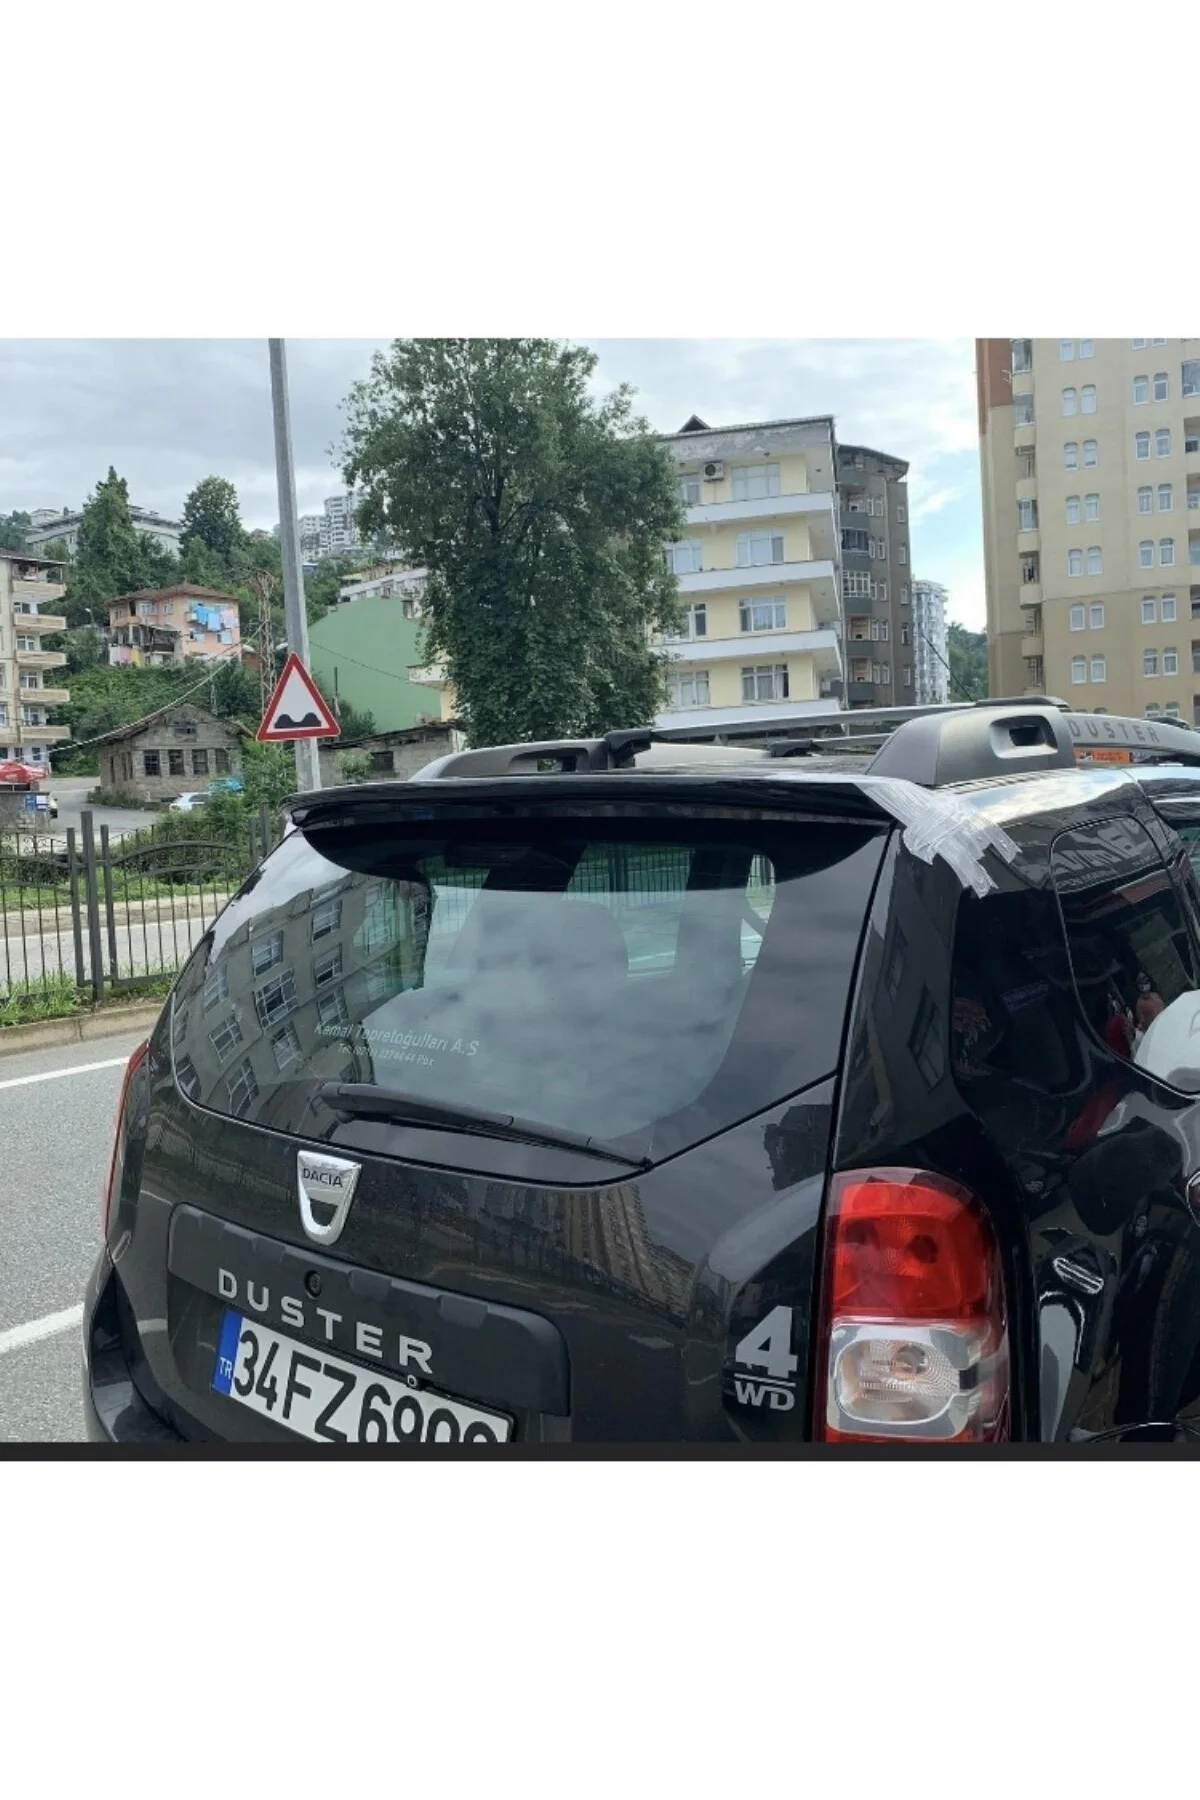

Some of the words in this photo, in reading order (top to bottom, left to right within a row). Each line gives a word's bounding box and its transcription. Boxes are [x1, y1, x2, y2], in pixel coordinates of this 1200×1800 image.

[1066, 718, 1160, 743] DUSTER
[303, 1167, 343, 1189] DACIA
[218, 1268, 433, 1374] DUSTER
[735, 1305, 798, 1378] 4
[219, 1356, 233, 1380] TR
[734, 1381, 796, 1411] WD
